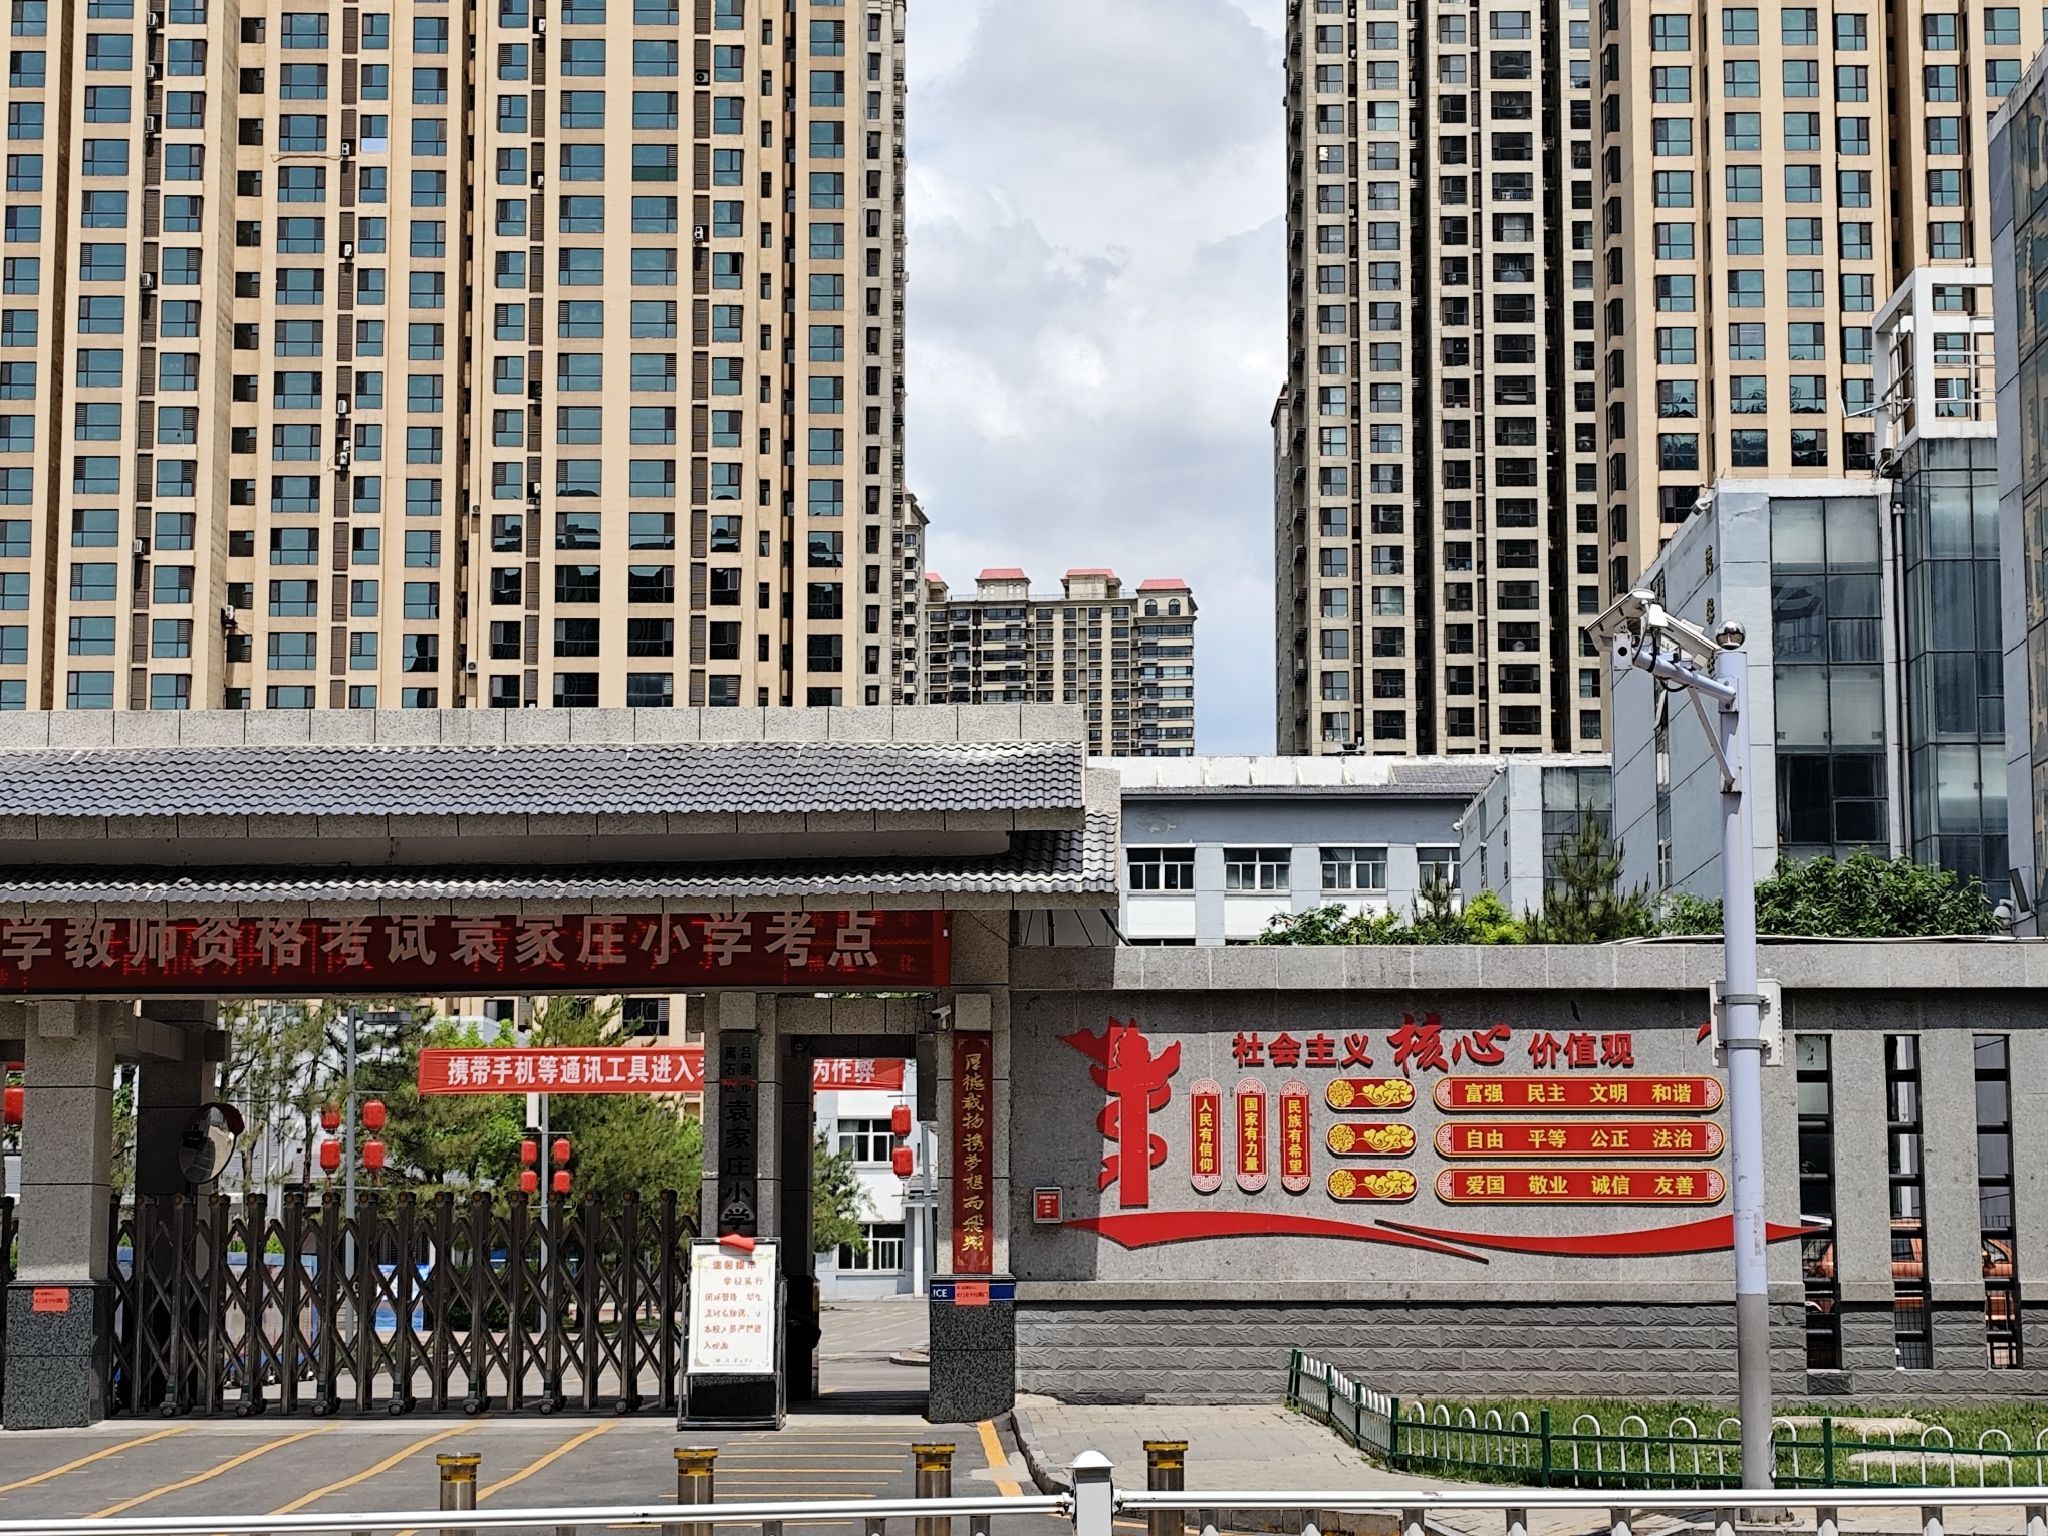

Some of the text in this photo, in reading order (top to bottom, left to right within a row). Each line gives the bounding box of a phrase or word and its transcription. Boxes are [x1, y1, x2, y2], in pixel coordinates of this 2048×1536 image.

[2, 911, 880, 970] 学教师资格考试袁家庄小学考点
[1464, 1083, 1692, 1104] 富强 民主 文明 和谐
[722, 1099, 753, 1231] 袁家庄小学
[1199, 1099, 1214, 1172] 人民有信仰
[1244, 1097, 1260, 1172] 国家有力量
[1287, 1099, 1304, 1173] 民族有希望
[1466, 1128, 1693, 1149] 自由 平等 公正 法治
[1466, 1175, 1695, 1196] 爱国 敬业 诚信 友善
